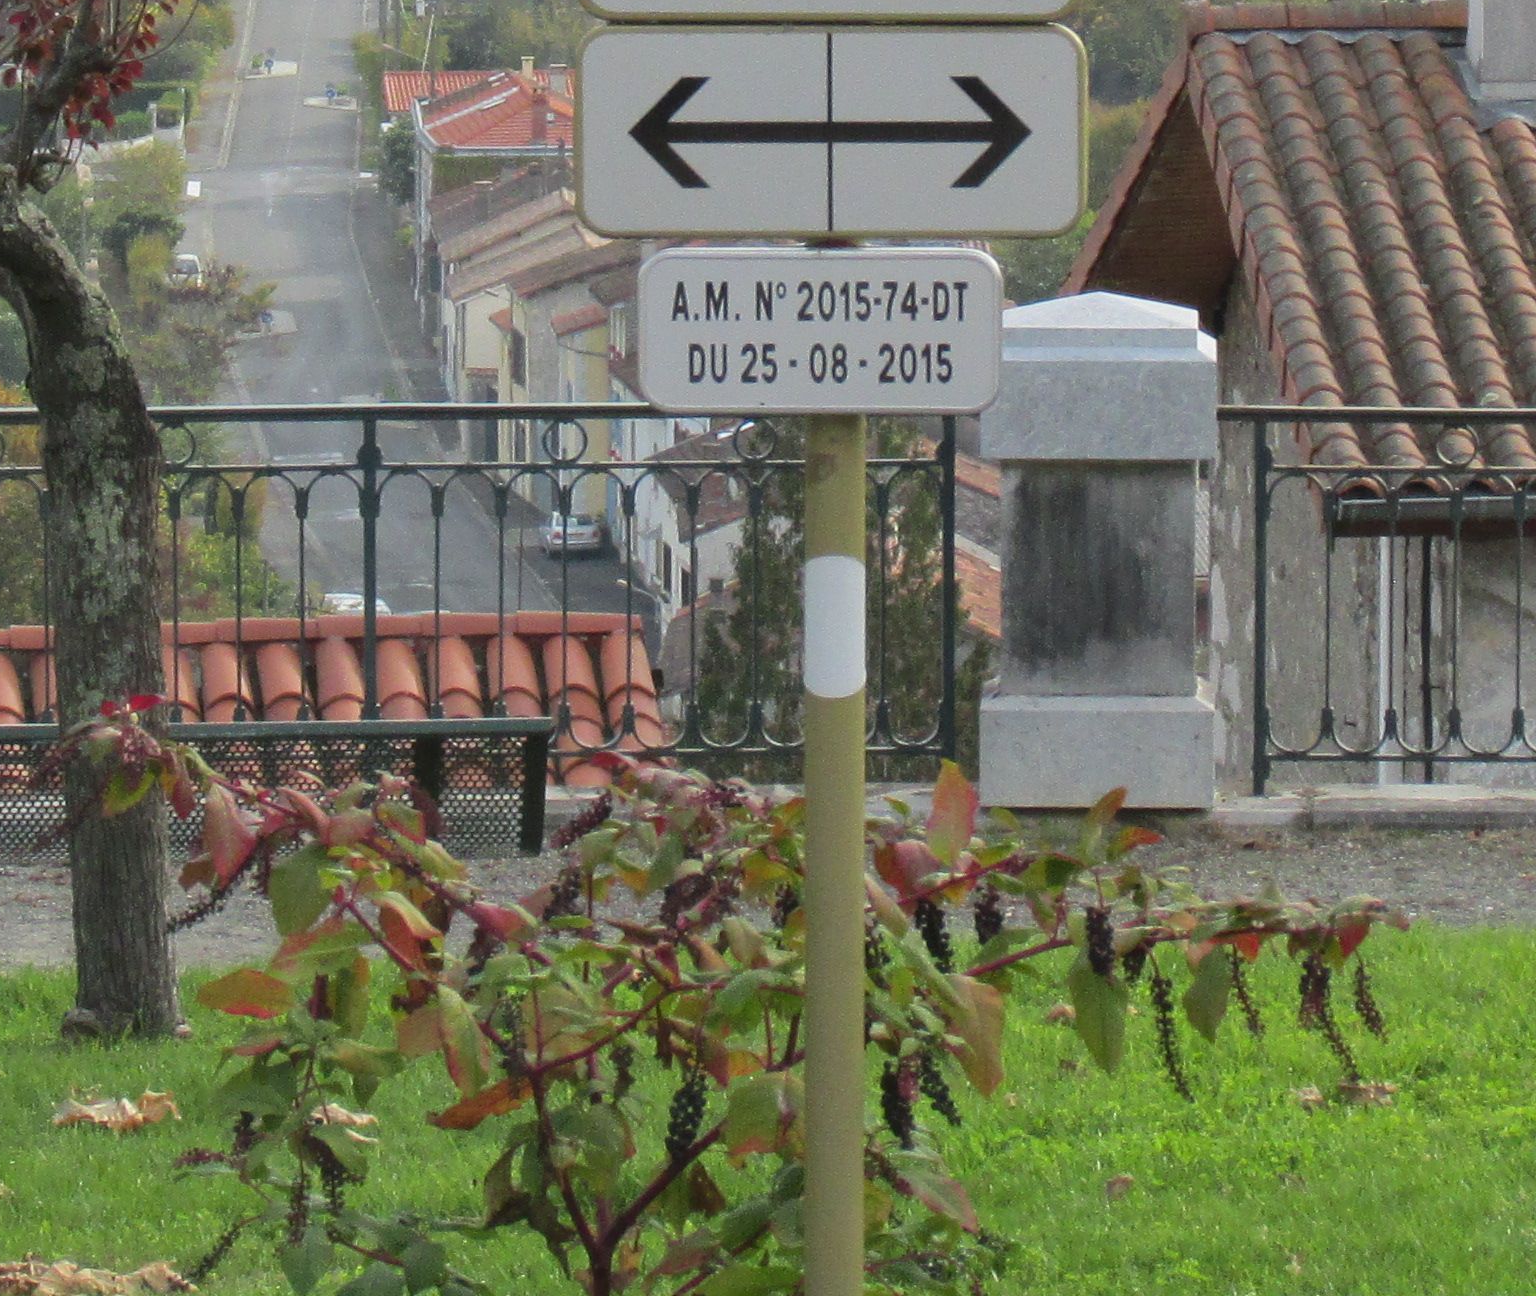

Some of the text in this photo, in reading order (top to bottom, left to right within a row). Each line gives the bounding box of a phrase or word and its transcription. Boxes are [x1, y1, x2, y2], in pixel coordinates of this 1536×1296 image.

[671, 281, 741, 322] A.M.
[797, 280, 969, 322] 2015-74-DT
[688, 343, 728, 384] DU
[878, 343, 953, 385] 2015
